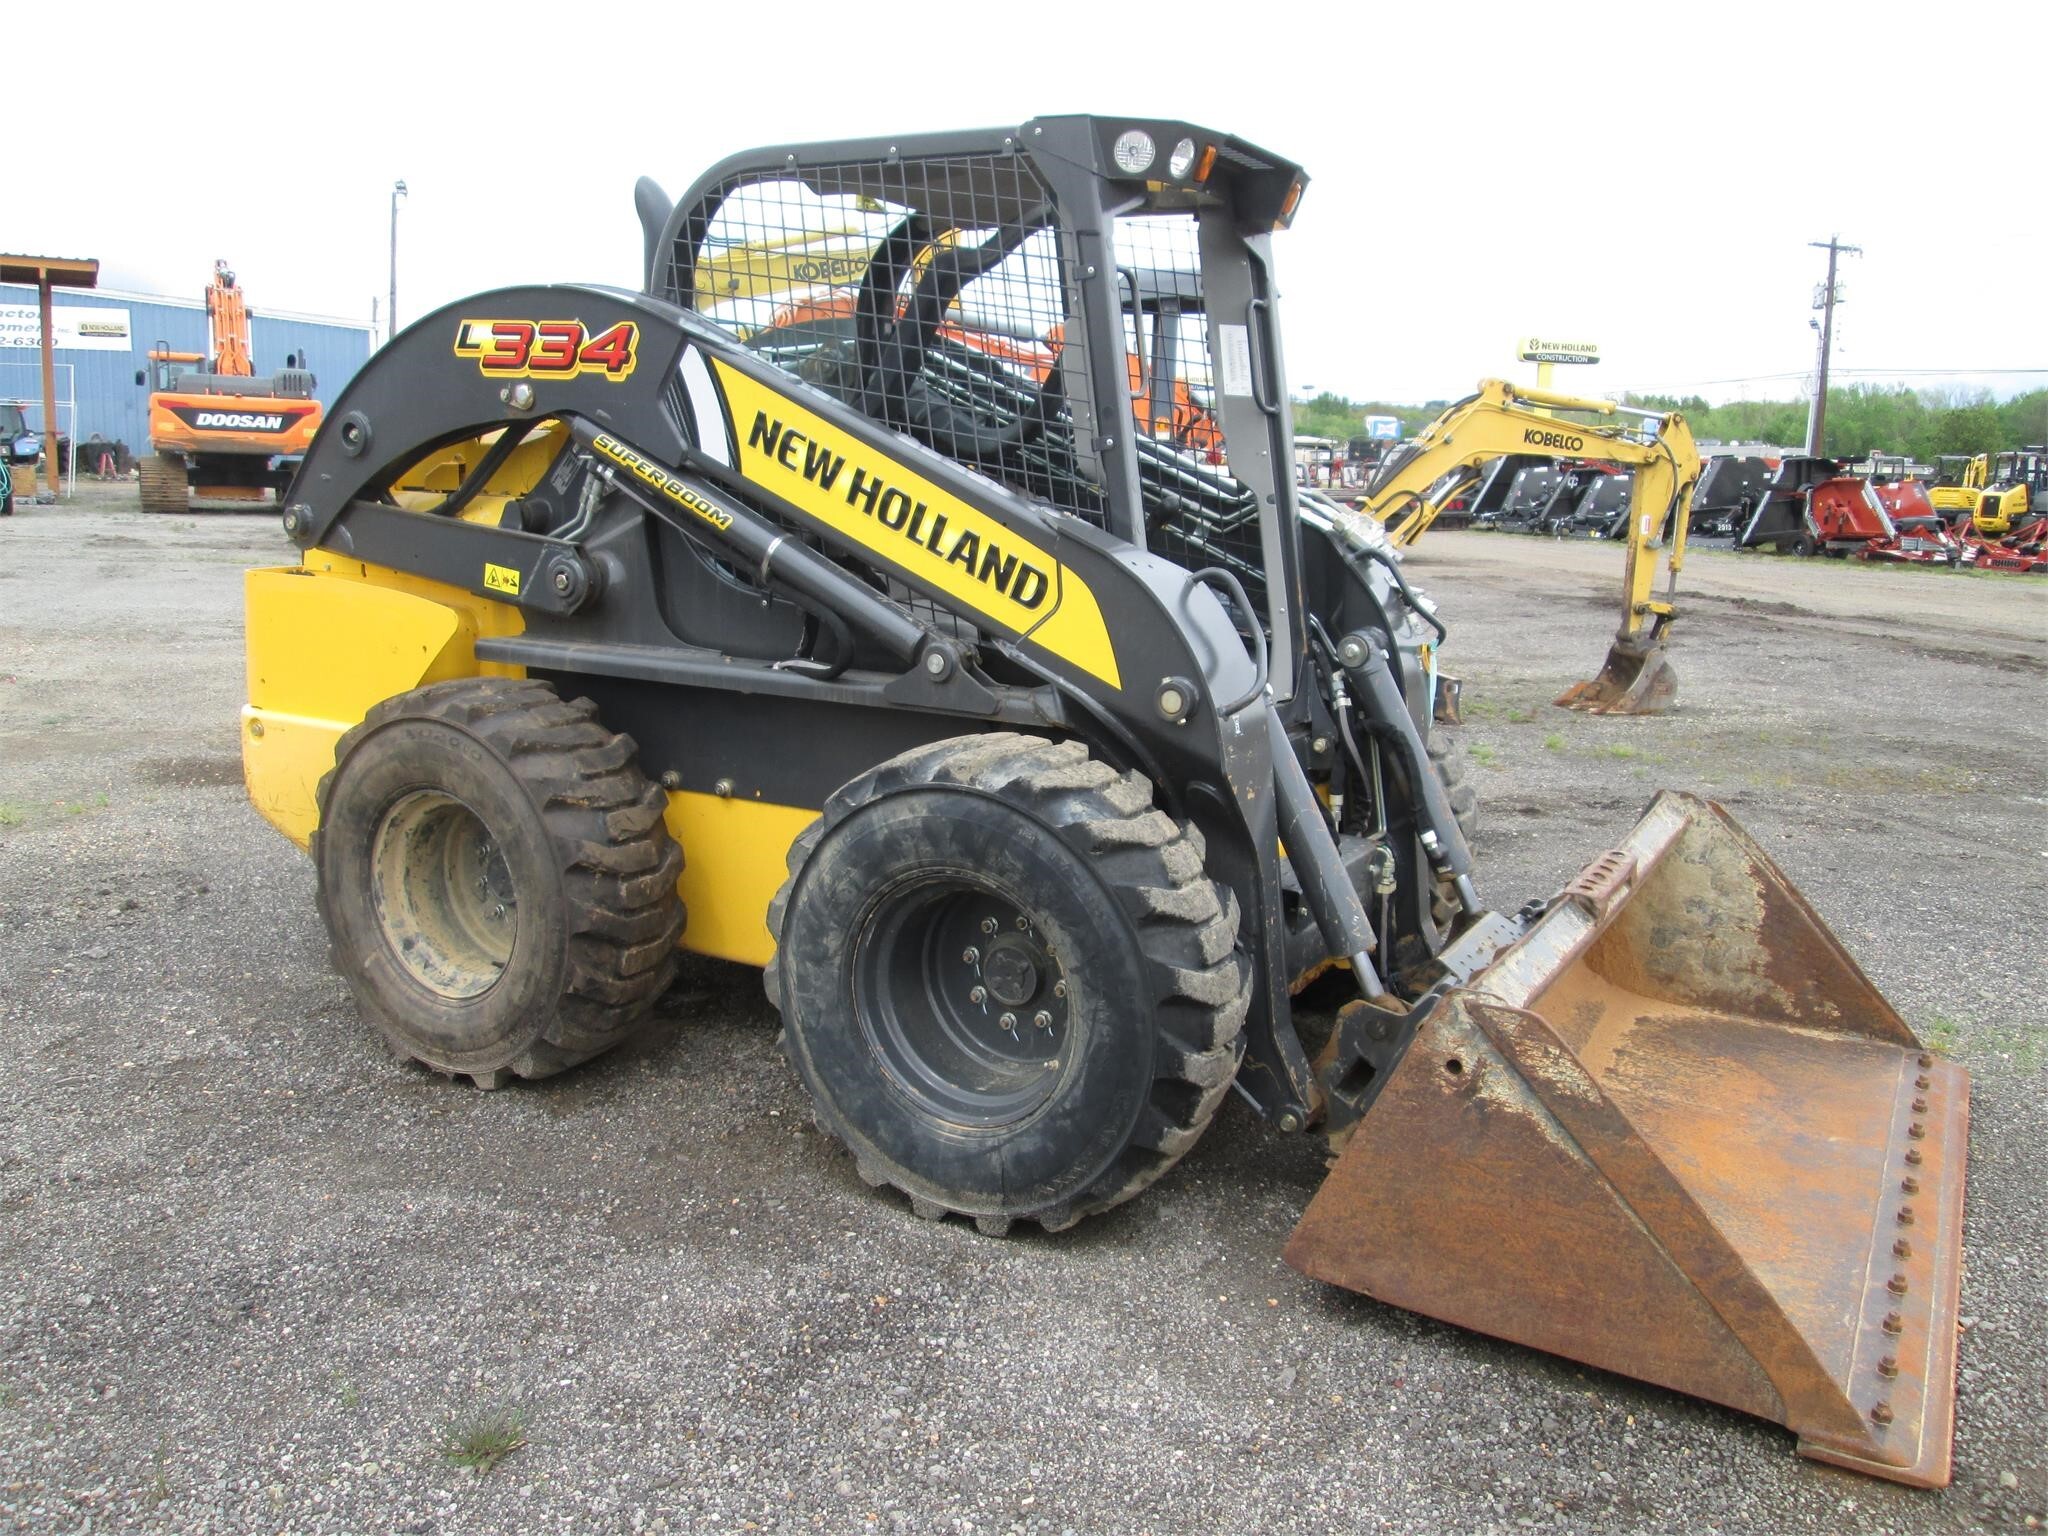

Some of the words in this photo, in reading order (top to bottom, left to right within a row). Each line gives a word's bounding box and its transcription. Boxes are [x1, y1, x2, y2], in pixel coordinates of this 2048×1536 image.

[793, 256, 867, 281] KOBELCO
[457, 320, 638, 376] L334
[1536, 353, 1588, 363] CONSTRUCTION
[1541, 342, 1560, 351] NEW
[1561, 343, 1597, 353] HOLLAND
[196, 412, 283, 429] DOOSAN
[1523, 427, 1584, 452] KOBELCO
[747, 409, 846, 492] NEW
[845, 466, 1050, 611] HOLLAND
